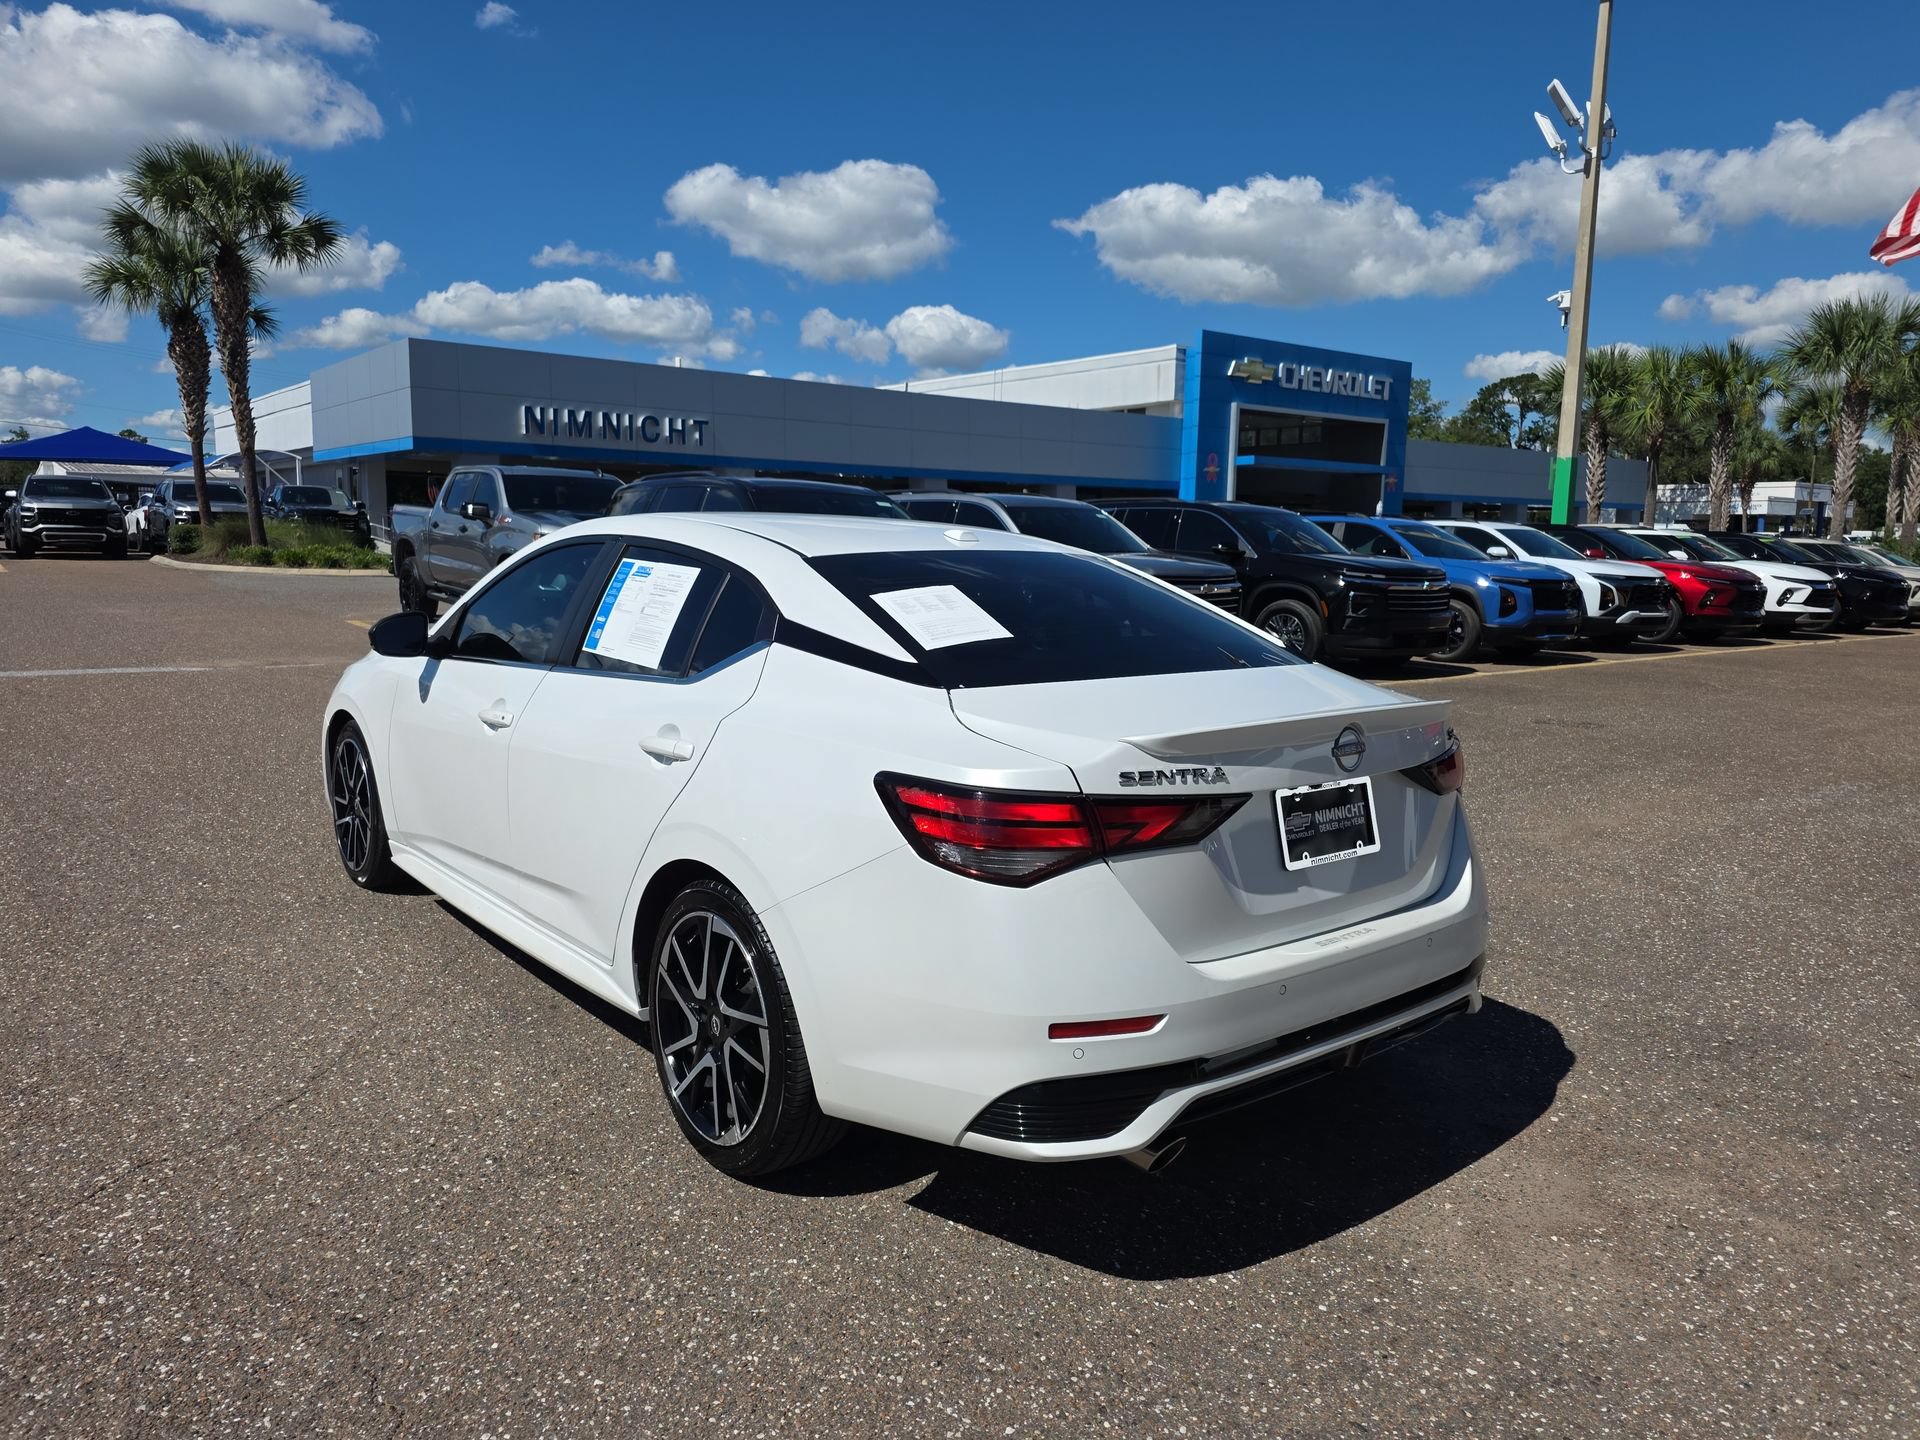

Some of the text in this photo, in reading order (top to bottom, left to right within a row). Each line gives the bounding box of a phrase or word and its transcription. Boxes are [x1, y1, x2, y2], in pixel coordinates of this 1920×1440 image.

[1279, 362, 1394, 401] CHEVROLET
[521, 404, 709, 447] NIMNICHT
[1119, 767, 1230, 787] SENTRA
[1314, 802, 1365, 824] NIMNICHT
[1319, 823, 1339, 833] DEALER
[1350, 816, 1365, 826] YEAR
[1311, 850, 1358, 866] nimnicht.com
